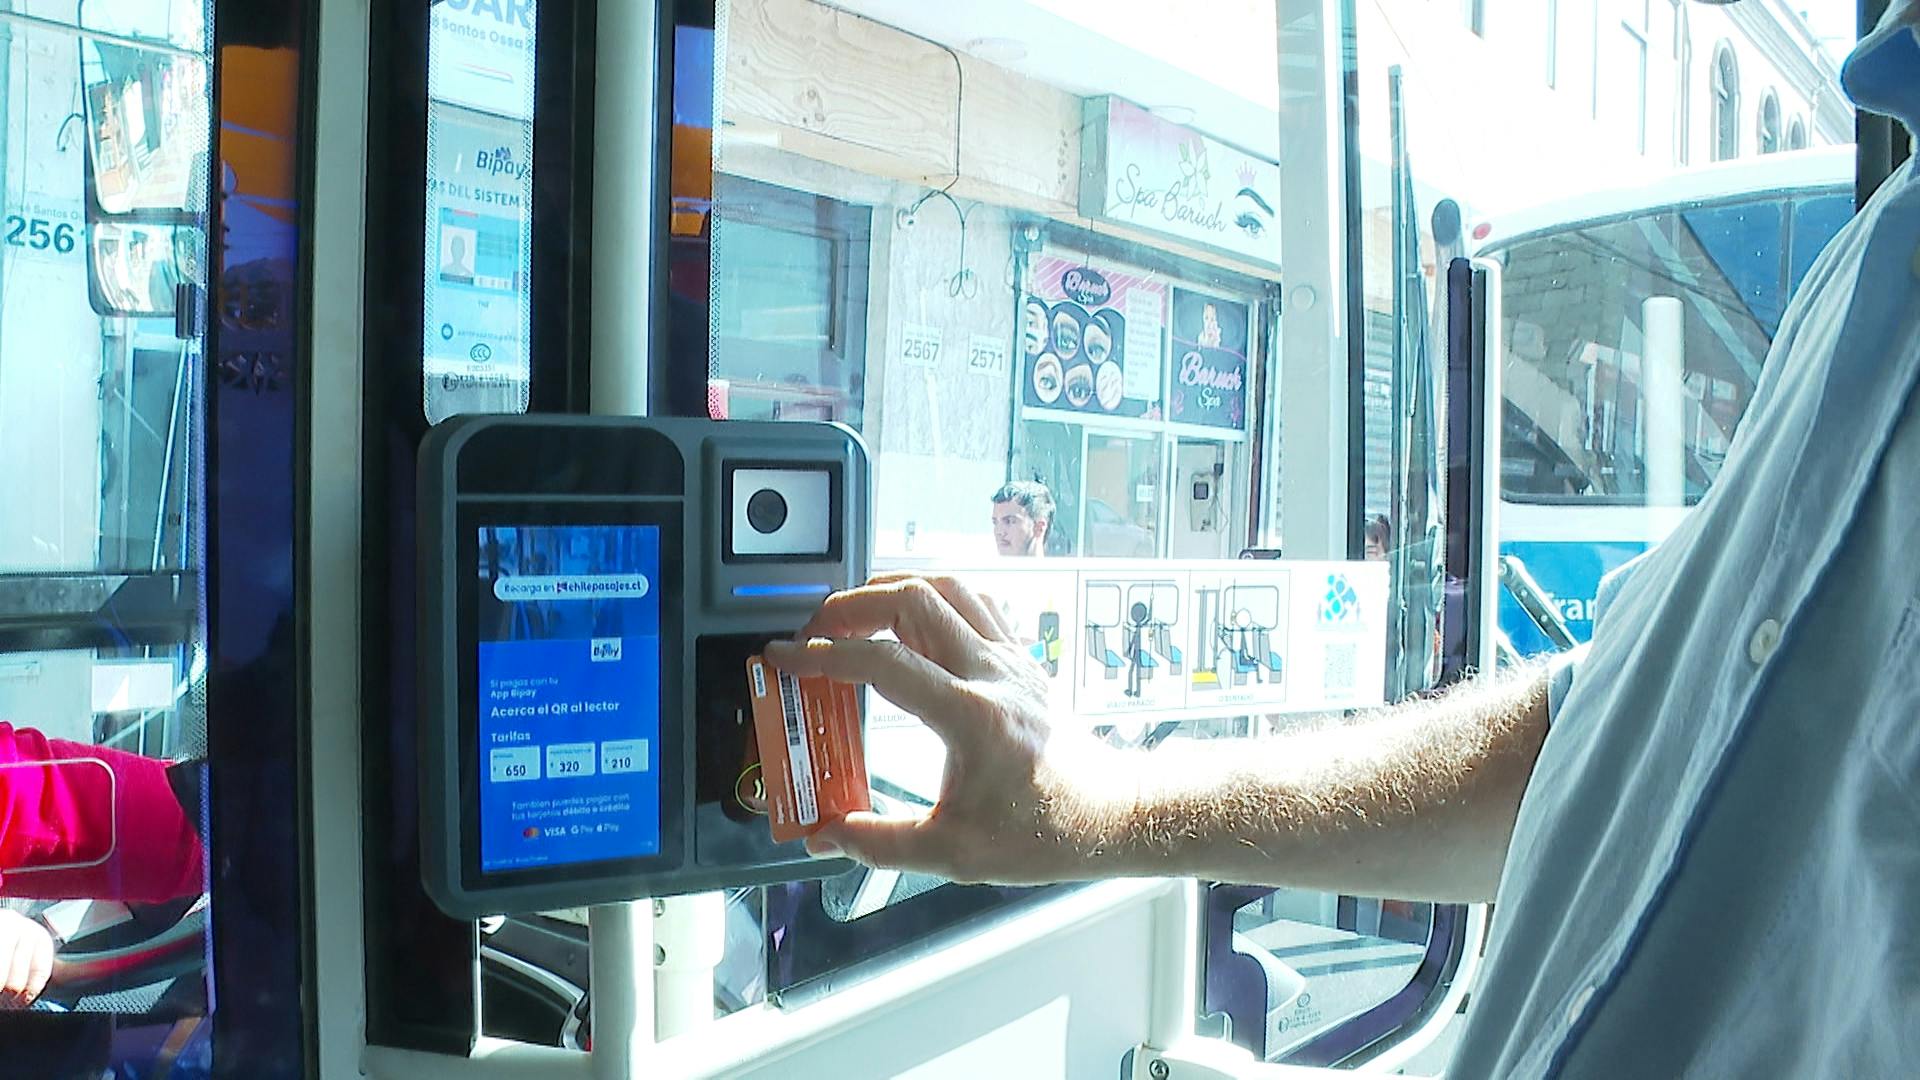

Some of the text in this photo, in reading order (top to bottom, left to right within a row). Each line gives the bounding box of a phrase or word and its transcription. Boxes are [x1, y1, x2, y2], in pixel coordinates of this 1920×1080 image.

[442, 18, 523, 48] Santos Ossa
[476, 149, 525, 180] Bipay
[448, 182, 471, 199] DEL
[474, 187, 521, 208] SISTEM
[1116, 163, 1227, 232] Spa Baruch
[5, 215, 84, 254] 256
[904, 338, 940, 362] 2567
[970, 348, 1003, 371] 2571
[1179, 351, 1242, 391] Baruch
[1197, 387, 1223, 411] Spa
[504, 582, 542, 595] Recarga
[570, 580, 641, 594] chilepasajes.cl
[491, 688, 537, 700] App Bipay
[491, 700, 620, 719] Acerca el QR al lector
[491, 729, 531, 743] Tarifas
[505, 757, 631, 777] 650 320 210
[544, 827, 566, 838] VISA
